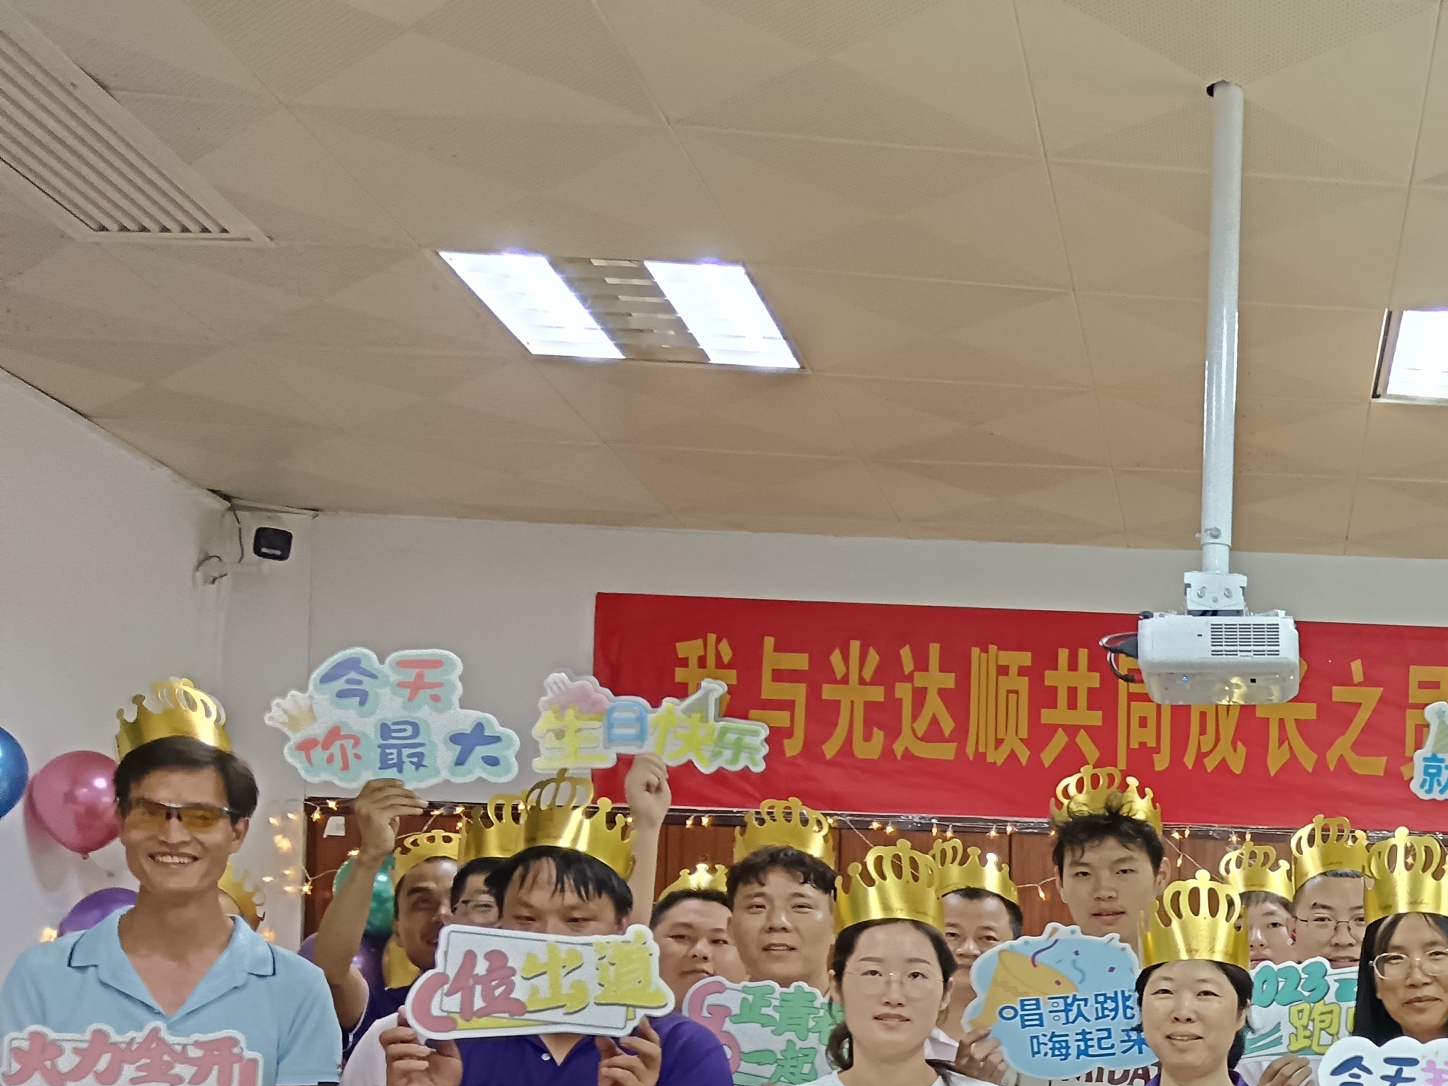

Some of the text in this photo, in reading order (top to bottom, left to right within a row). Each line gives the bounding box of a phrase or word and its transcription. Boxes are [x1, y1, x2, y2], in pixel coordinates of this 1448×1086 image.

[319, 656, 446, 708] 今天
[295, 719, 502, 773] 你最大
[534, 699, 767, 769] 生日快乐
[1250, 961, 1330, 1008] 023
